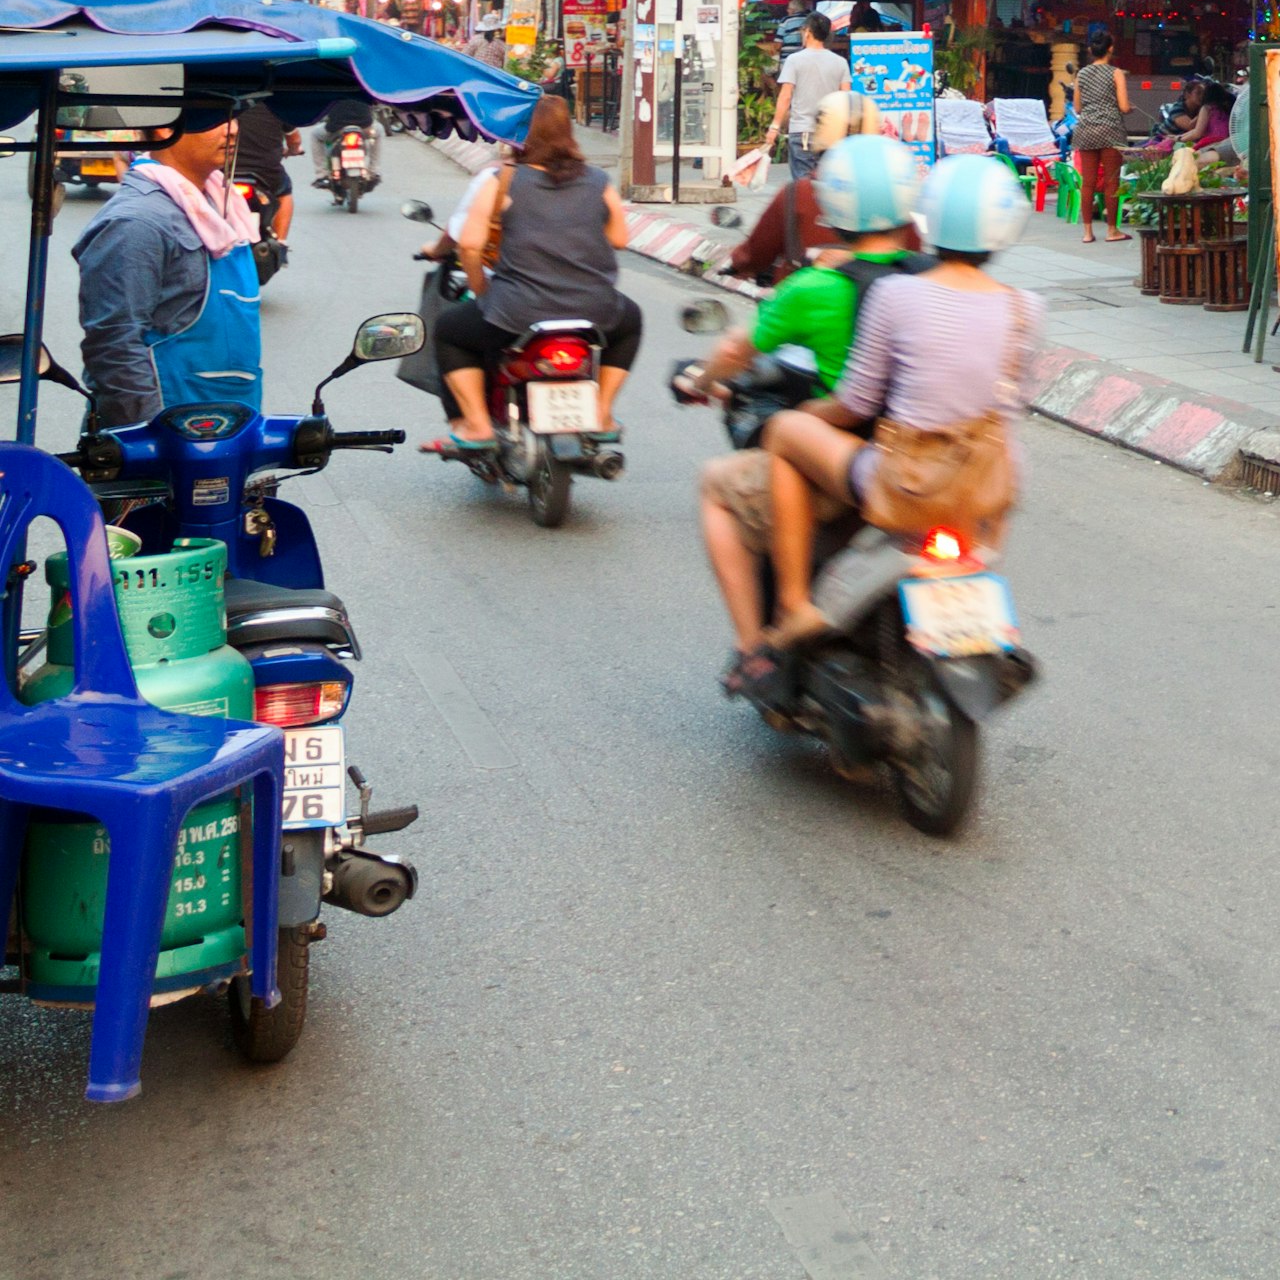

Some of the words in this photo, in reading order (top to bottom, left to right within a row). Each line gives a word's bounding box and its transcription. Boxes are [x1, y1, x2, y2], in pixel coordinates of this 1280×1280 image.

[175, 851, 205, 867] 16.3
[175, 876, 206, 893] 15.0
[176, 900, 207, 917] 31.3
